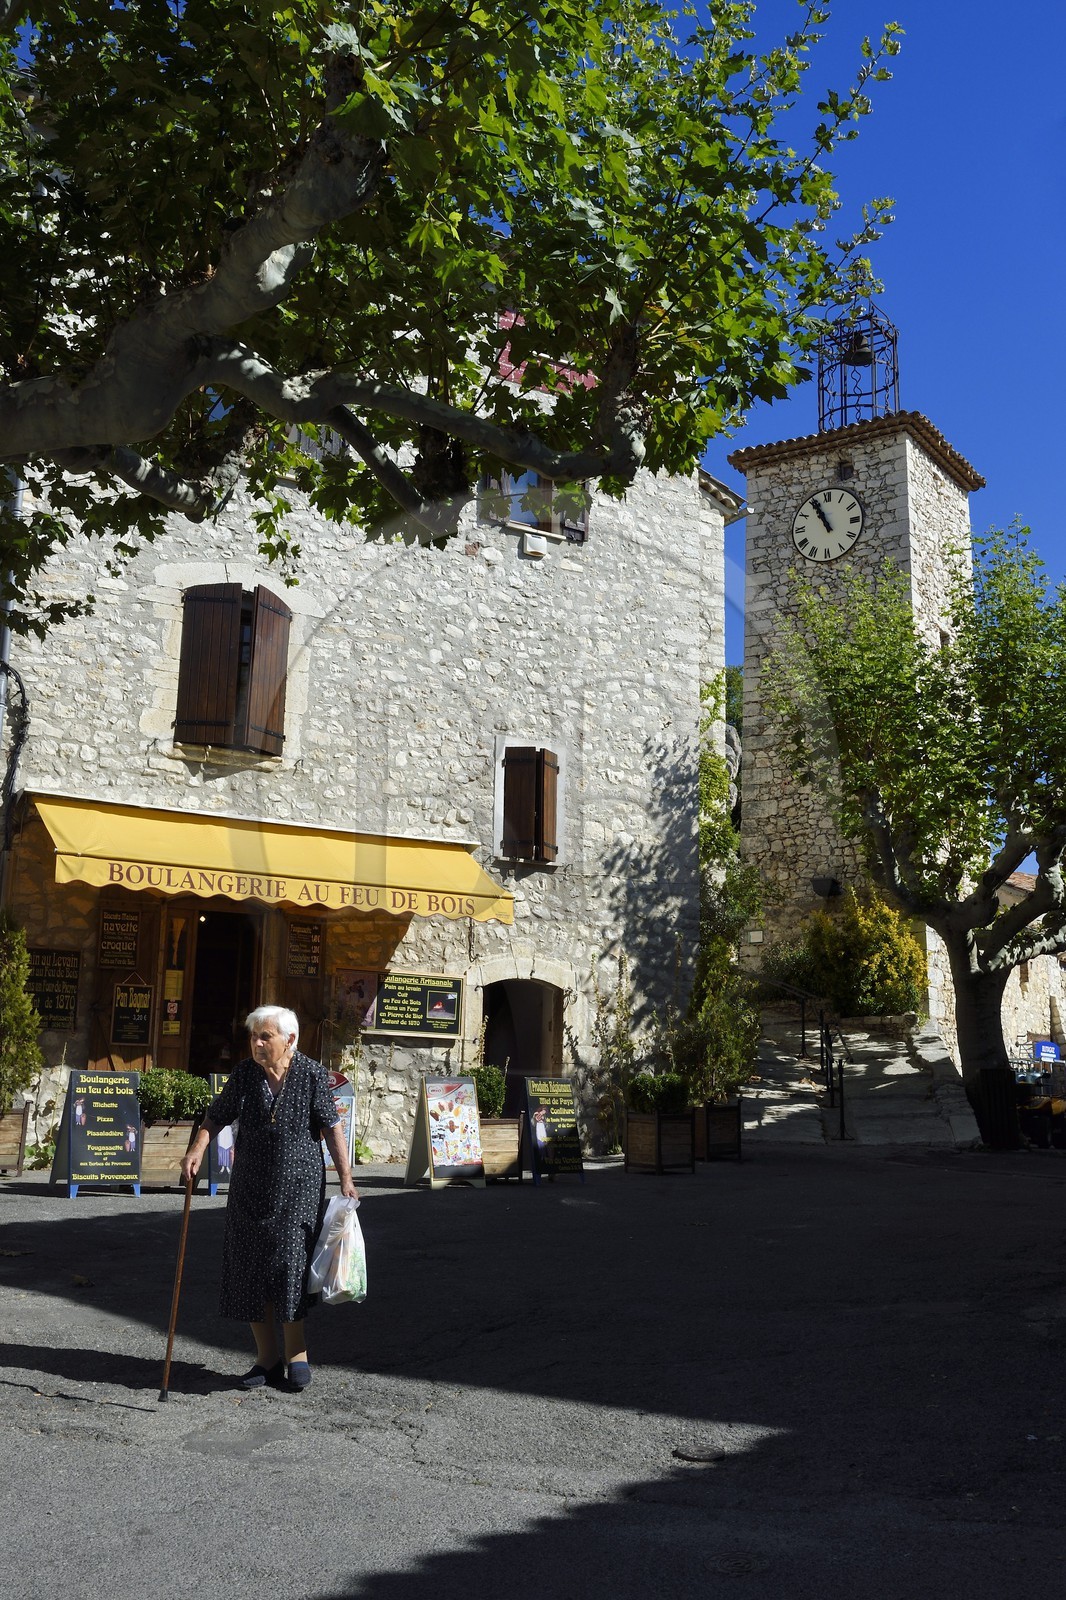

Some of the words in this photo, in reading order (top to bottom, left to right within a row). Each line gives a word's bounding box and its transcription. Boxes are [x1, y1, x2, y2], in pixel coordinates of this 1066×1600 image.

[846, 501, 857, 512] II
[850, 516, 861, 525] III
[108, 862, 288, 899] BOULANGERIE
[297, 883, 331, 903] AU
[339, 886, 380, 907] FEU
[391, 891, 419, 911] DE
[427, 894, 476, 916] BOIS
[103, 922, 139, 933] navette
[101, 940, 137, 953] croquet
[41, 954, 51, 967] au
[52, 952, 79, 968] Levain
[420, 978, 453, 988] Artisanale
[56, 994, 76, 1010] 1870
[115, 986, 128, 1008] Pan
[387, 1011, 404, 1019] Pierre
[80, 1074, 130, 1085] Boulangerie
[75, 1086, 87, 1094] au
[88, 1085, 102, 1095] feu
[103, 1086, 114, 1095] de
[115, 1086, 134, 1096] bois
[92, 1101, 119, 1109] Michette
[559, 1097, 574, 1106] Pays
[87, 1144, 124, 1152] Fougassette
[72, 1173, 99, 1181] Biscuits
[100, 1173, 139, 1182] Provençaux
